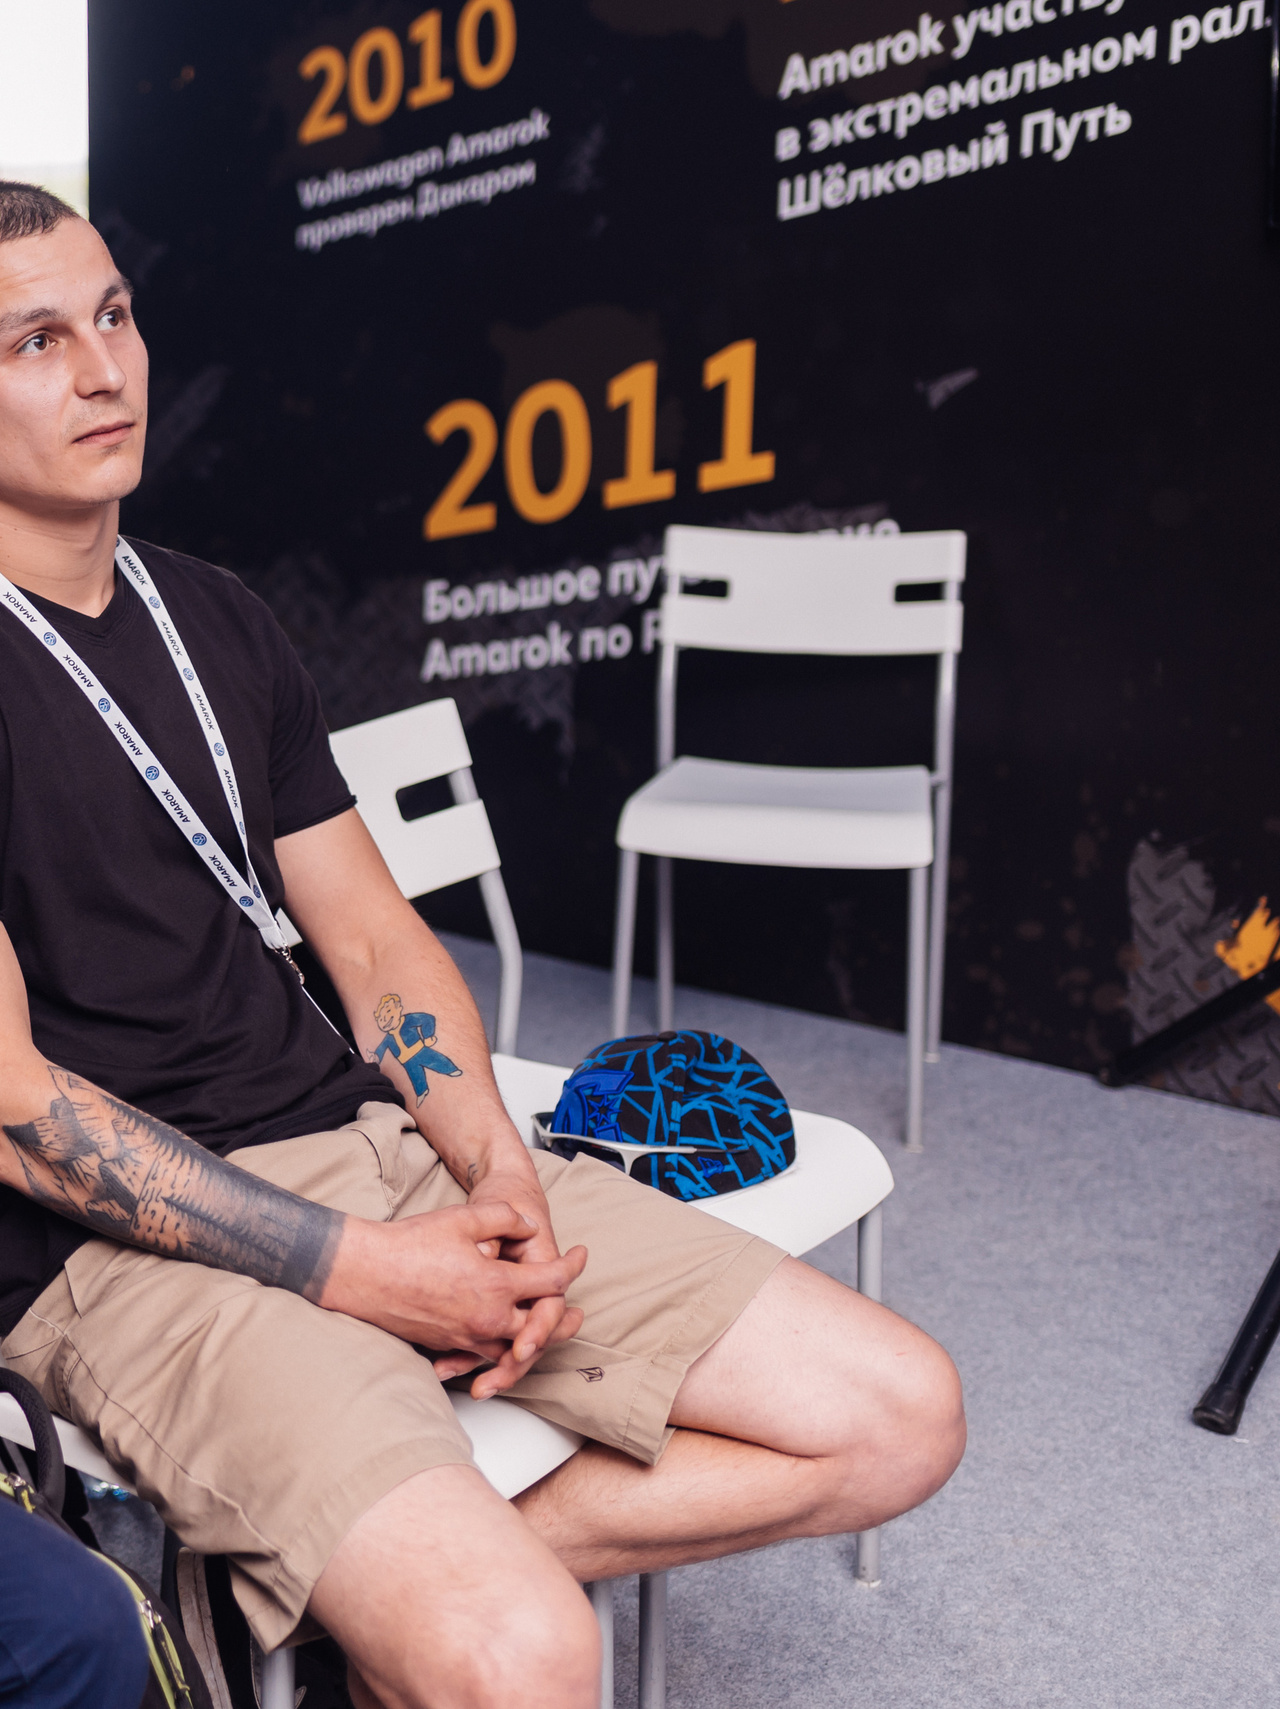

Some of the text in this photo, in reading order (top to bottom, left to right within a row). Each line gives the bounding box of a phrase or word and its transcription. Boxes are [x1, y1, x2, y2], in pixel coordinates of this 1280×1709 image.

[778, 0, 1124, 100] Amarok учас
[298, 0, 517, 145] 2010
[775, 0, 1273, 162] в экстремальном рал
[296, 107, 550, 209] Volkswagen Amarok
[777, 102, 1132, 221] Шёлковый Путь
[424, 338, 776, 541] 2011
[122, 555, 148, 586] AMAROK
[3, 591, 37, 623] AMAROK
[423, 565, 601, 623] Большое
[160, 620, 182, 657] AMAROK
[421, 621, 571, 682] Amarok
[579, 623, 633, 664] по
[63, 653, 94, 689] AMAROK
[195, 692, 215, 731] AMAROK
[114, 721, 144, 757] AMAROK
[162, 789, 191, 823] AMAROK
[223, 768, 239, 809] AMAROK
[208, 854, 238, 888] AMAROK
